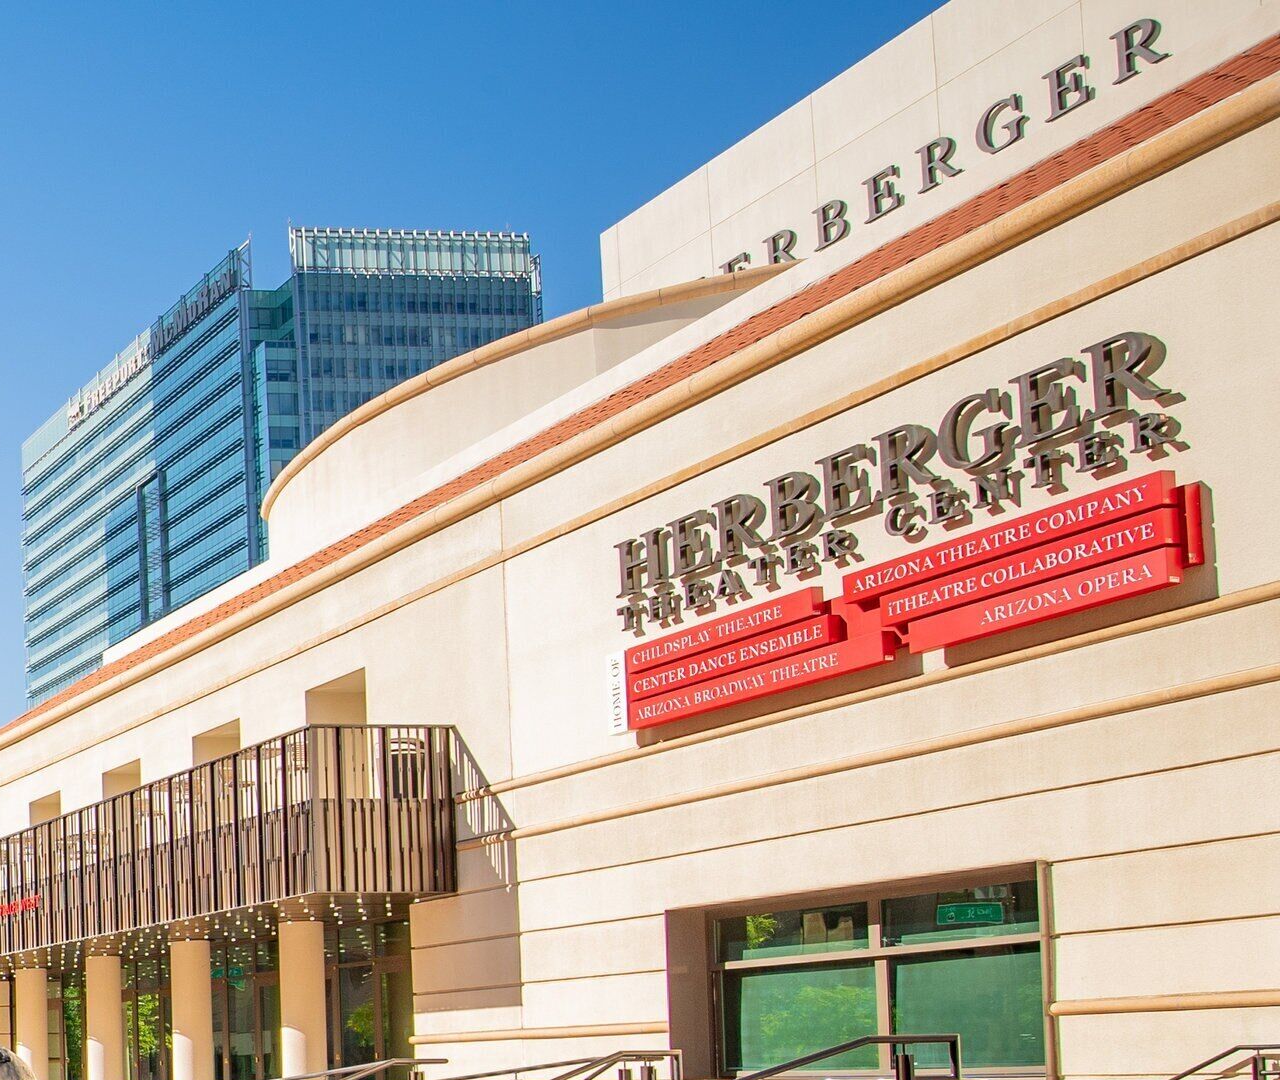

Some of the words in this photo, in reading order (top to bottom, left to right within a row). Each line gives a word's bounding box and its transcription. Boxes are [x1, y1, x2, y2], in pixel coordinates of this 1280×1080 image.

[700, 18, 1172, 279] RBERGER
[613, 331, 1180, 600] HERBERGER
[617, 530, 861, 634] THEATER
[885, 411, 1185, 540] CENTER
[853, 556, 935, 593] ARIZONA
[937, 524, 1032, 566] THEATRE
[1035, 484, 1148, 534] COMPANY
[888, 578, 978, 616] iTHEATRE
[980, 522, 1156, 588] COLLABORATIVE
[980, 587, 1072, 626] ARIZONA
[1078, 563, 1153, 597] OPERA
[611, 658, 621, 678] OF
[633, 627, 711, 665] CHILDSPLAY
[715, 605, 783, 637] THEATRE
[633, 664, 686, 693] CENTER
[689, 650, 736, 676] DANCE
[739, 624, 823, 662] ENSEMBLE
[612, 681, 623, 729] HOME
[636, 696, 691, 721] ARIZONA
[694, 672, 766, 704] BROADWAY
[770, 652, 839, 683] THEATRE
